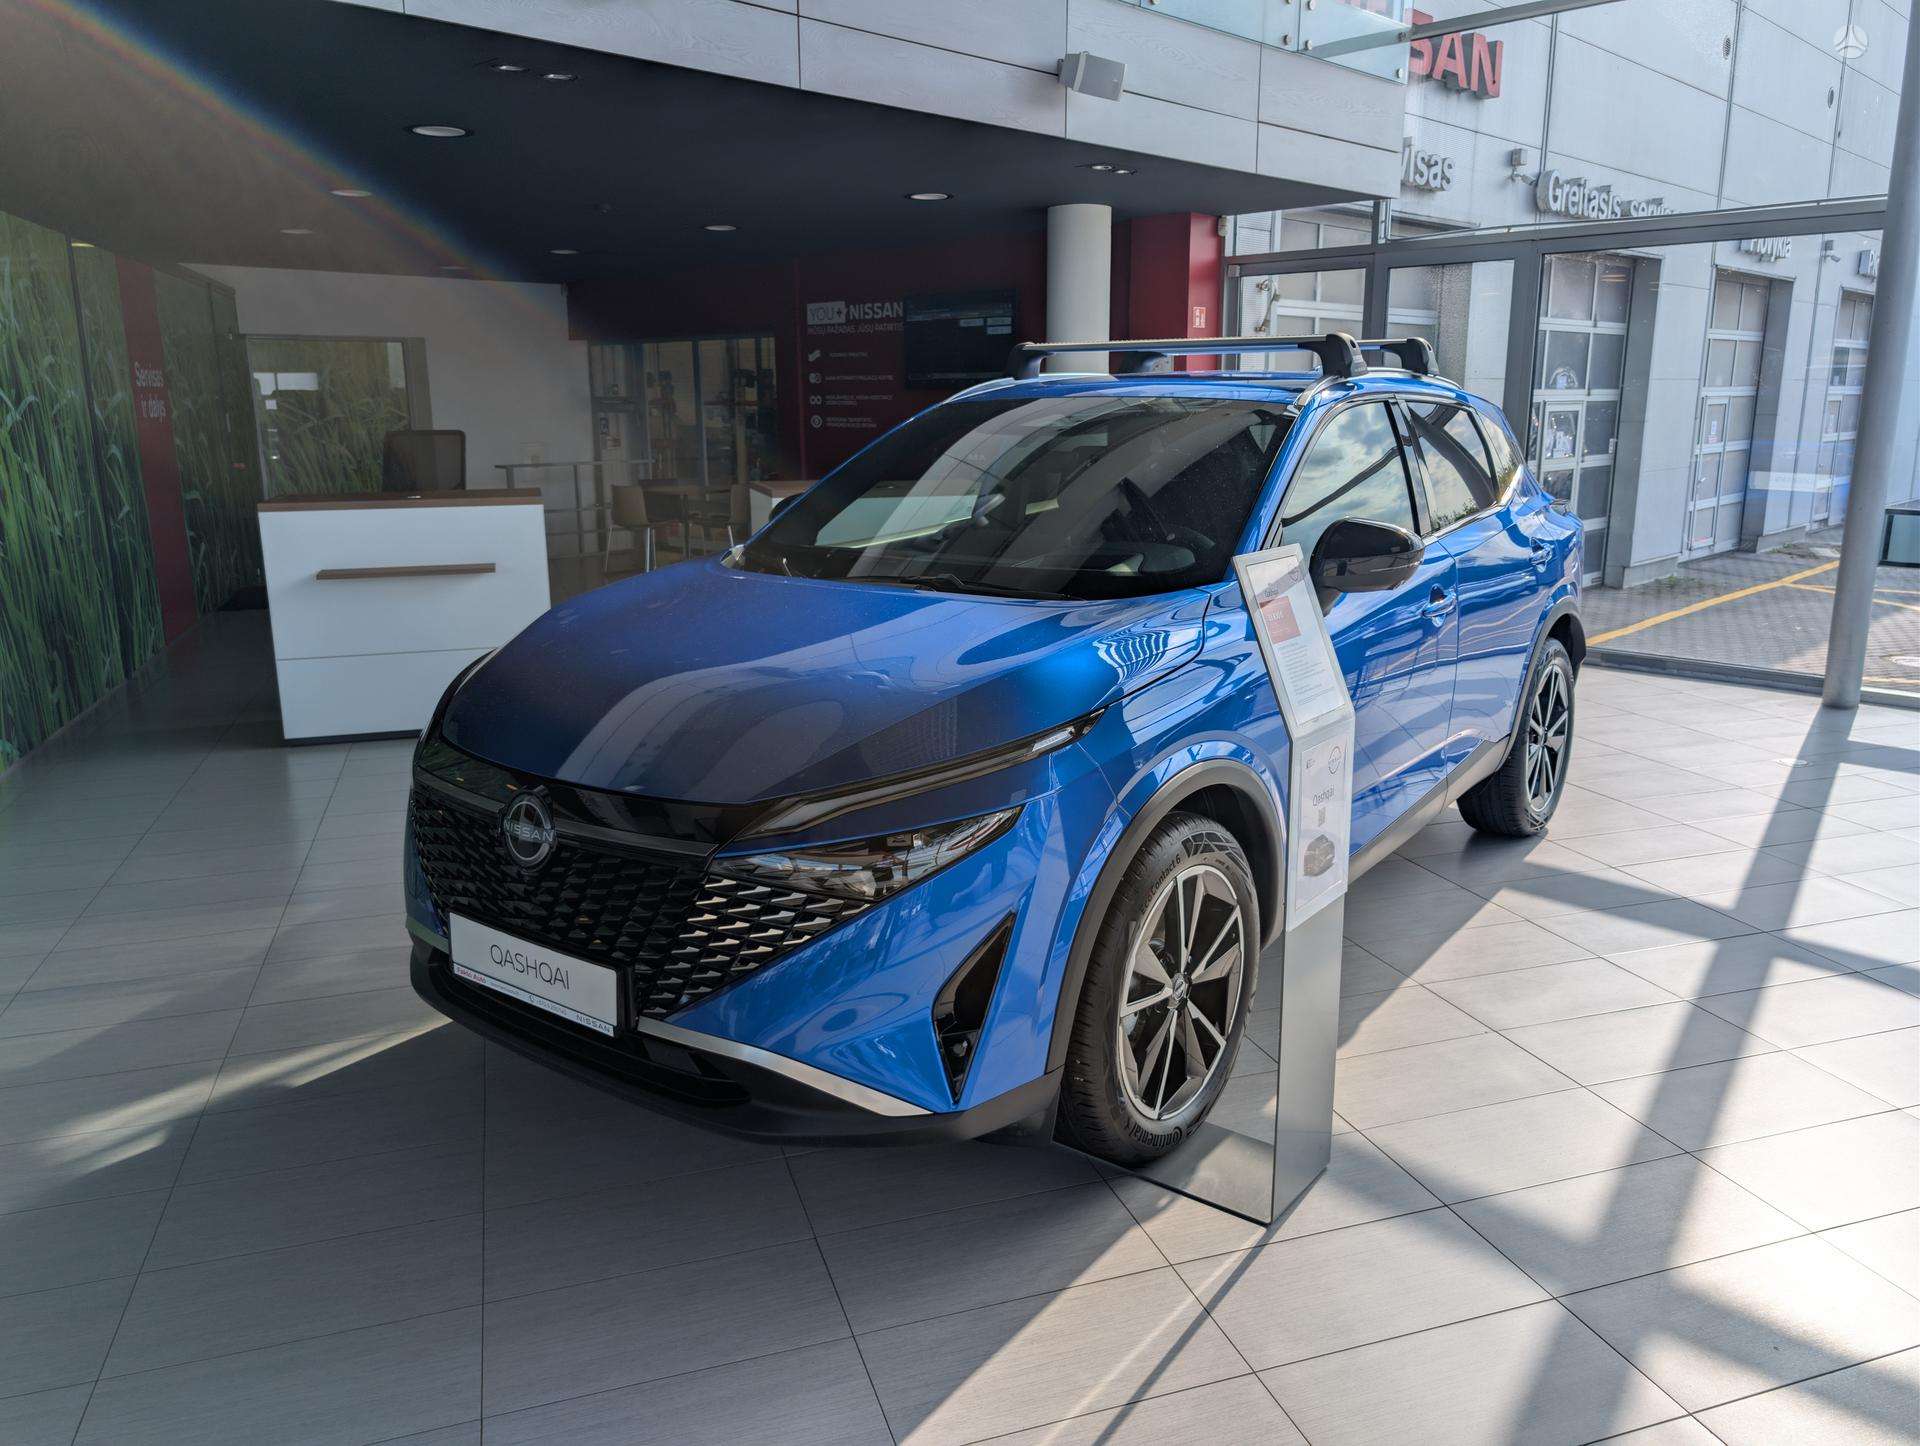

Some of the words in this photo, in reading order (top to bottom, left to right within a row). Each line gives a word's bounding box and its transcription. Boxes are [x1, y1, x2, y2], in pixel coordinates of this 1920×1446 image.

[1548, 170, 1622, 219] Greitasis
[849, 302, 903, 320] NISSAN
[504, 819, 554, 842] NISSAN
[490, 944, 570, 990] QASHQAI
[576, 1013, 610, 1033] NISSAN
[1128, 1122, 1183, 1148] Continental
